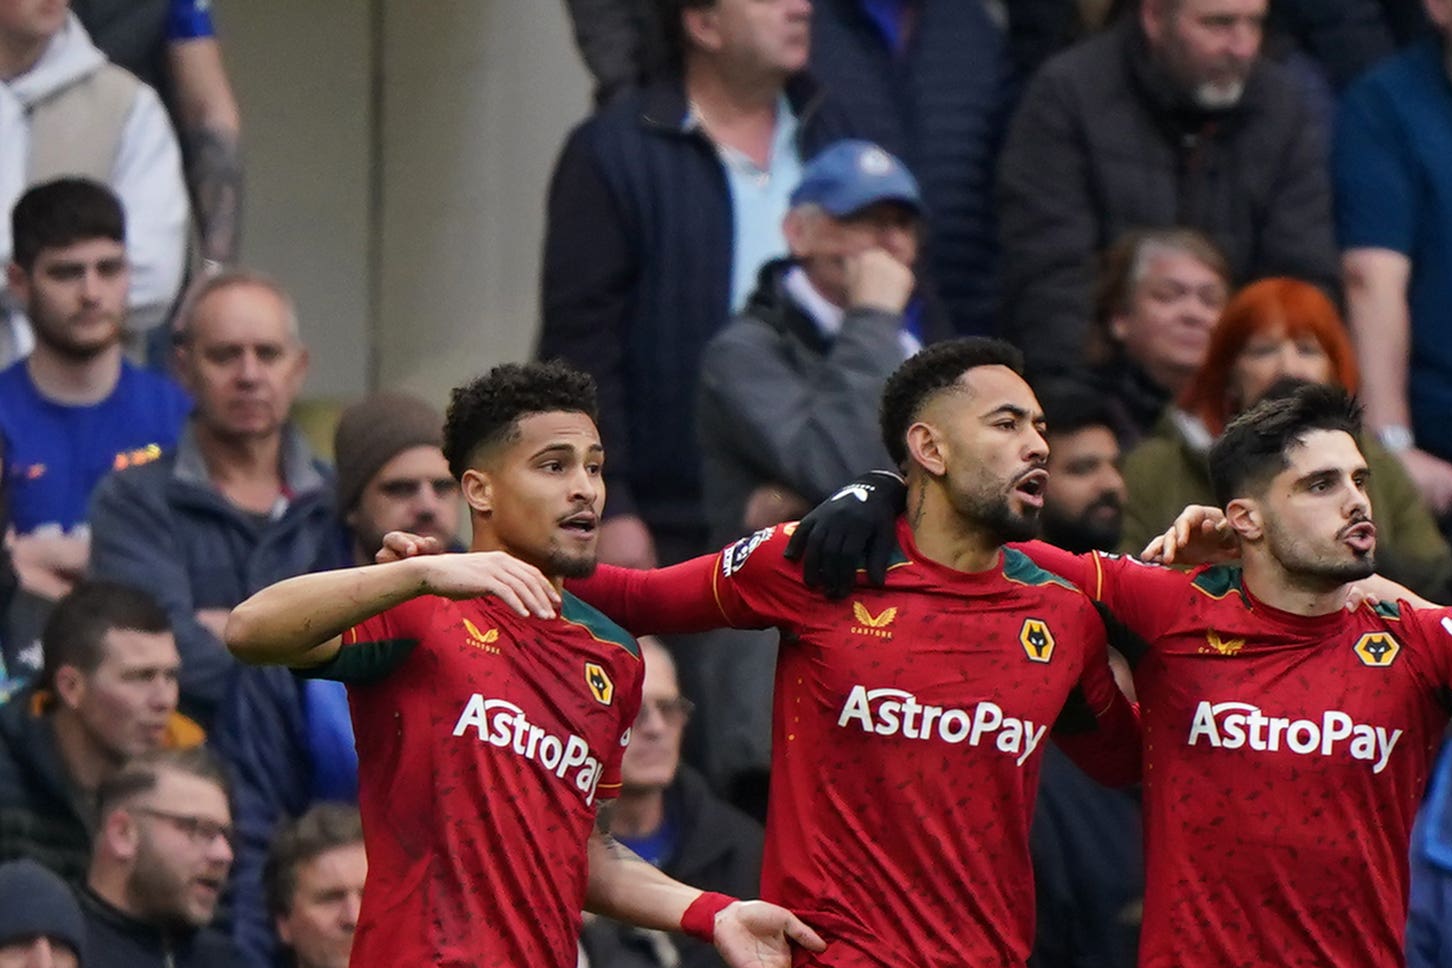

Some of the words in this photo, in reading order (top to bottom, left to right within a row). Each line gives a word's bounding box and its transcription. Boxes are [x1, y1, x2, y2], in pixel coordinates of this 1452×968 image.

[453, 693, 602, 806] AstroPay
[838, 684, 1047, 767] AstroPay
[1188, 701, 1403, 774] AstroPay
